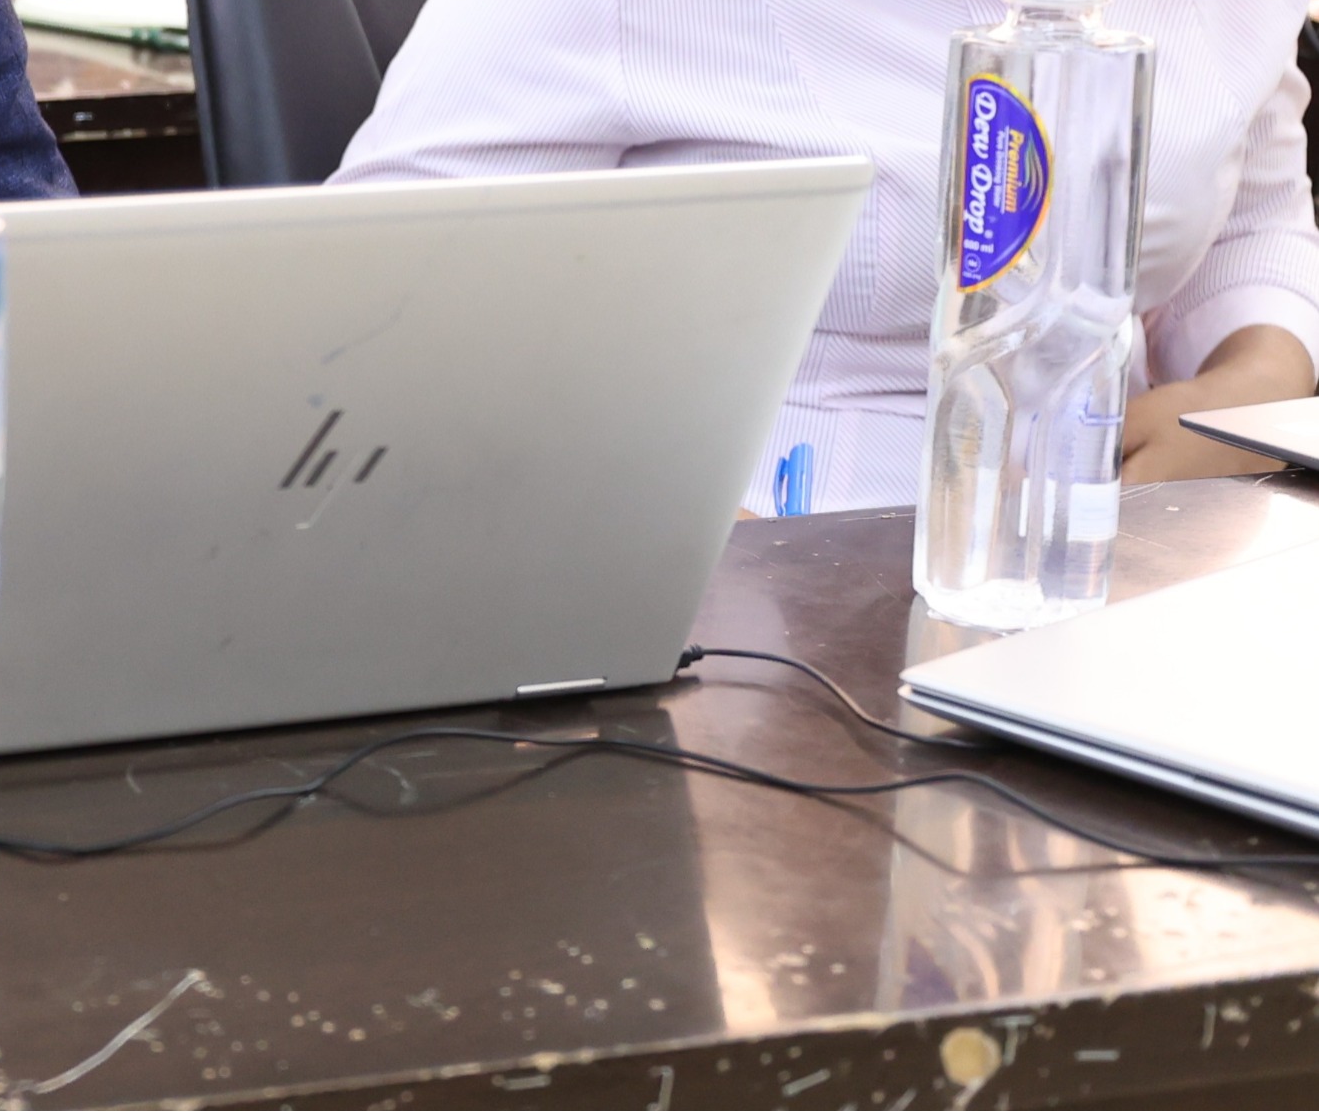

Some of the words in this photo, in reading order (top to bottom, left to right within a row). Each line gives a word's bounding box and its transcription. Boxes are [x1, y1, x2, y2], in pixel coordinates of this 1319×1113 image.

[972, 91, 997, 159] Dew
[963, 163, 993, 235] Drop
[1006, 129, 1025, 213] Premium
